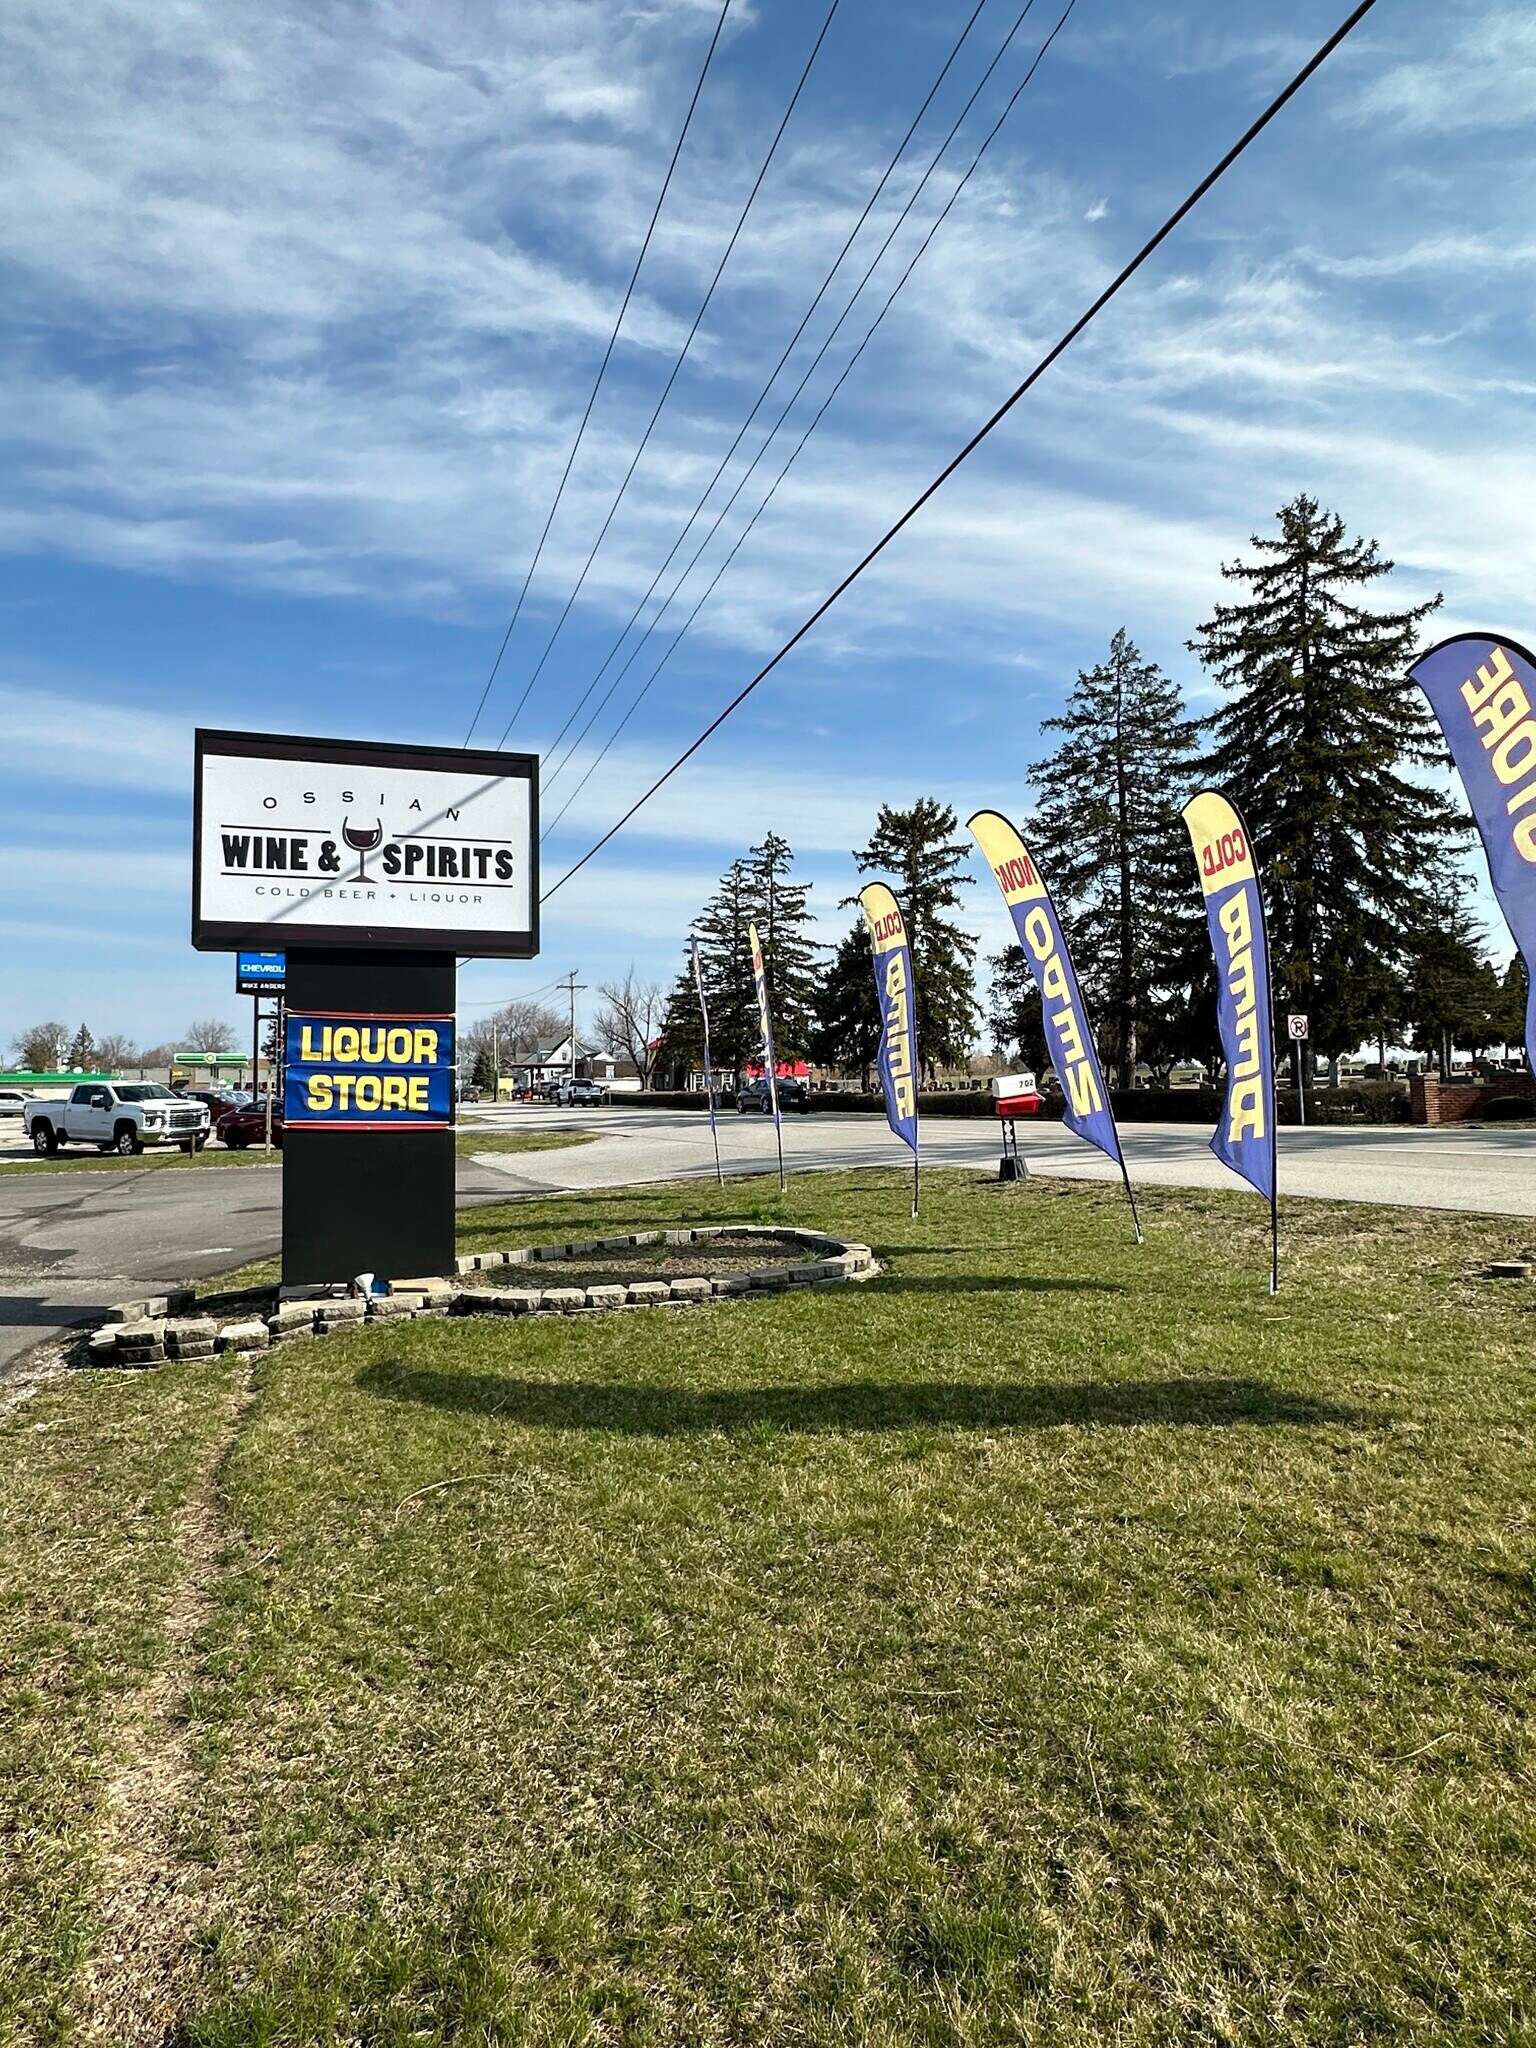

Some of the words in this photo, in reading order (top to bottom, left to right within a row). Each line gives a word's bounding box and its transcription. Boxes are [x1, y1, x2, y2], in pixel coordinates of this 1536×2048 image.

[263, 791, 460, 822] OSSIAN
[220, 833, 309, 871] WINE
[318, 840, 341, 872] &
[382, 843, 514, 881] SPIRITS
[255, 886, 310, 898] COLD
[324, 889, 376, 900] BEER
[410, 893, 482, 904] LIQUOR
[241, 964, 286, 973] CHEVROL
[301, 1025, 438, 1064] LIQUOR
[307, 1074, 430, 1112] STORE
[1019, 1079, 1034, 1088] 702
